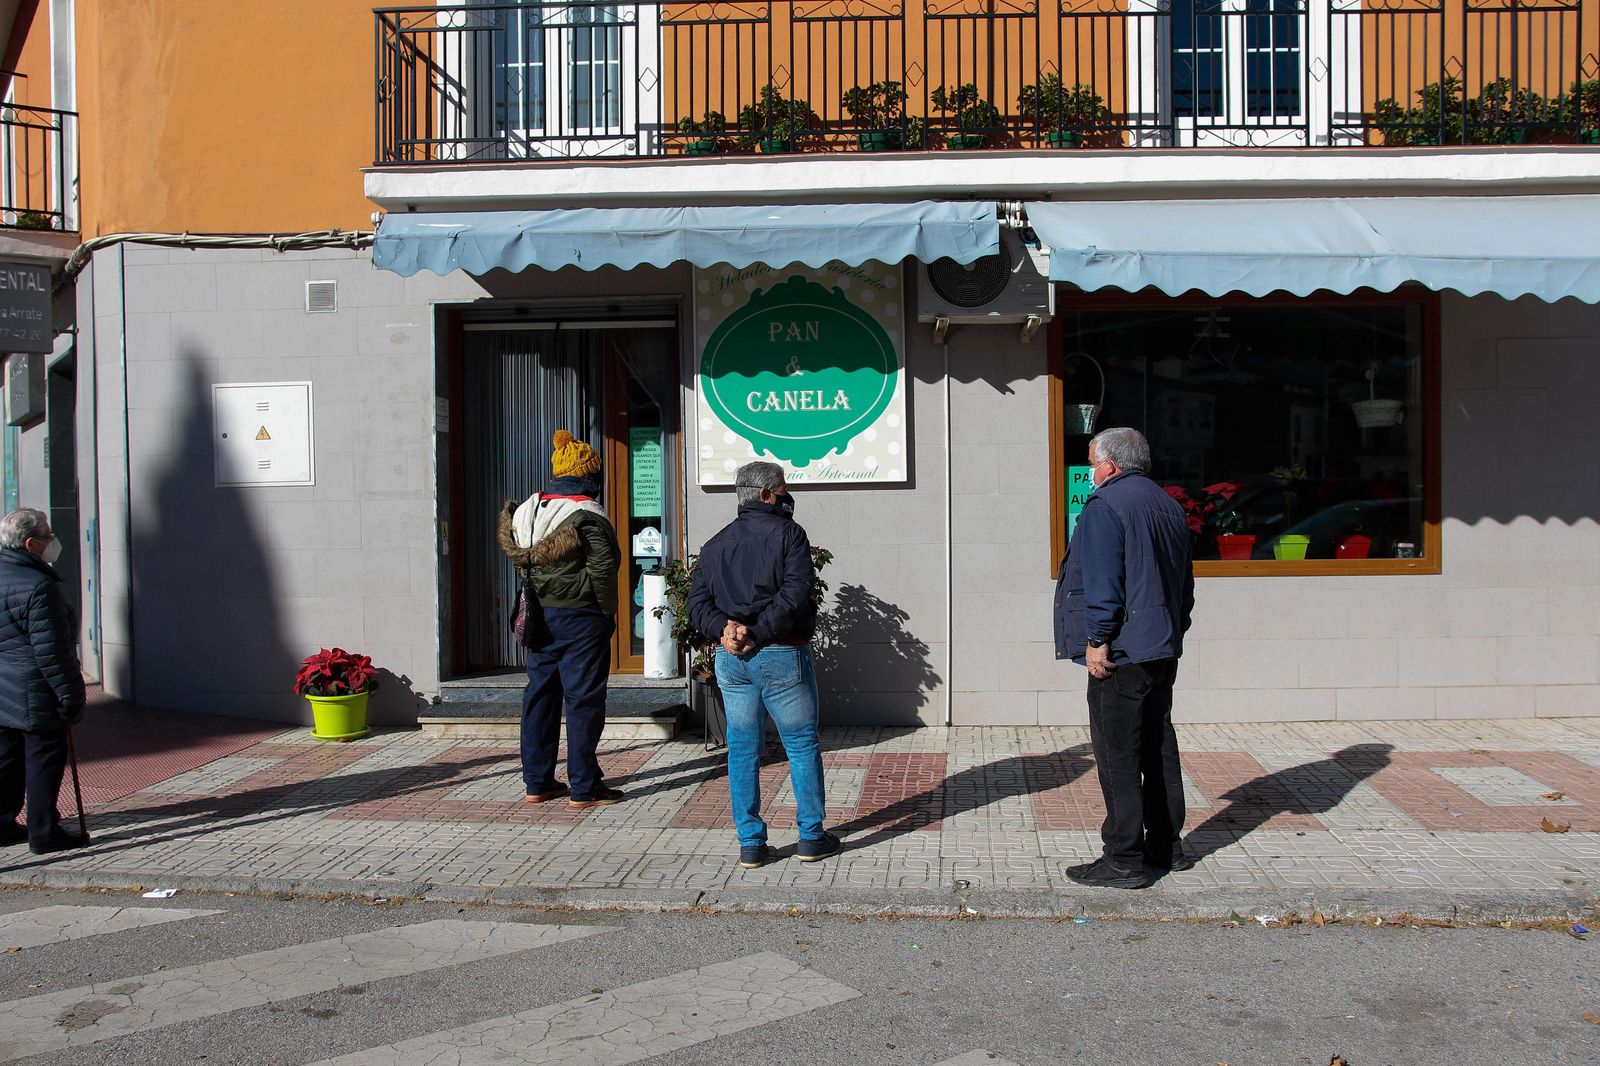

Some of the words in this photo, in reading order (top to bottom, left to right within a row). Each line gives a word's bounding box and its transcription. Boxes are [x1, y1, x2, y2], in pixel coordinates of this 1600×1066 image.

[0, 271, 45, 291] ENTAL
[10, 306, 42, 320] Arrate
[768, 320, 821, 342] PAN
[785, 355, 804, 377] &
[746, 389, 852, 412] CANELA
[808, 464, 879, 481] Artesanal
[1074, 473, 1089, 483] PA
